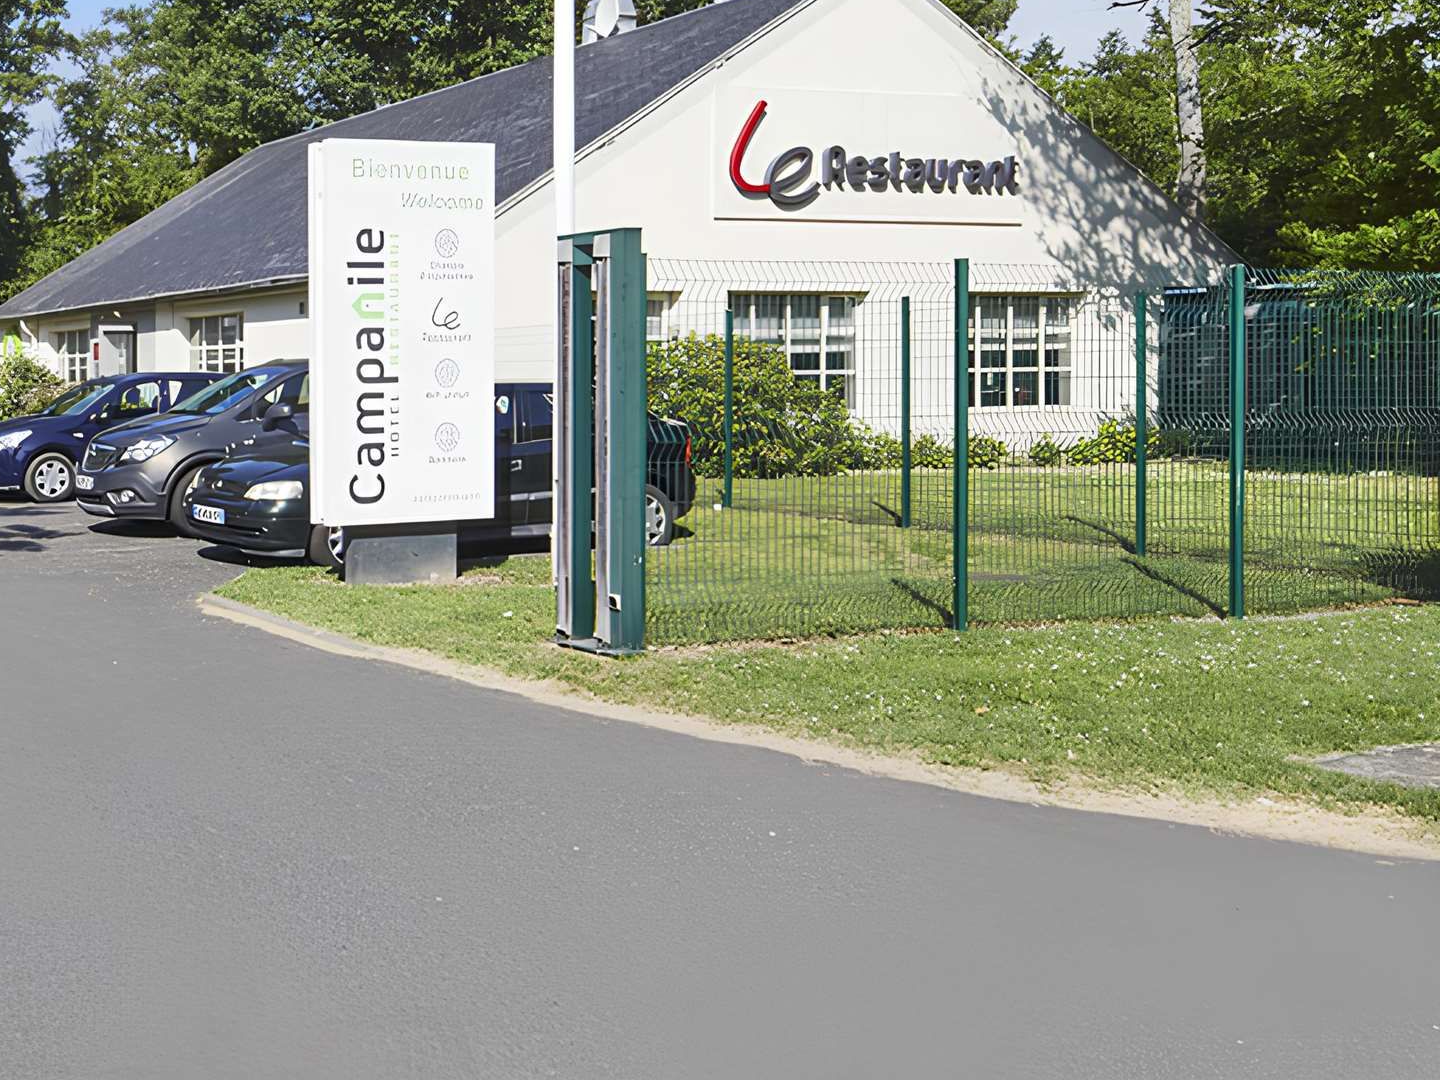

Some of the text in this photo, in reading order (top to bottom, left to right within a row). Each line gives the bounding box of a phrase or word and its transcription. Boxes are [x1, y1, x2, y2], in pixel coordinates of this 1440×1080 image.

[352, 158, 469, 180] Bienvenue
[729, 100, 1020, 211] Le Restaurant
[347, 228, 399, 504] Campanile
